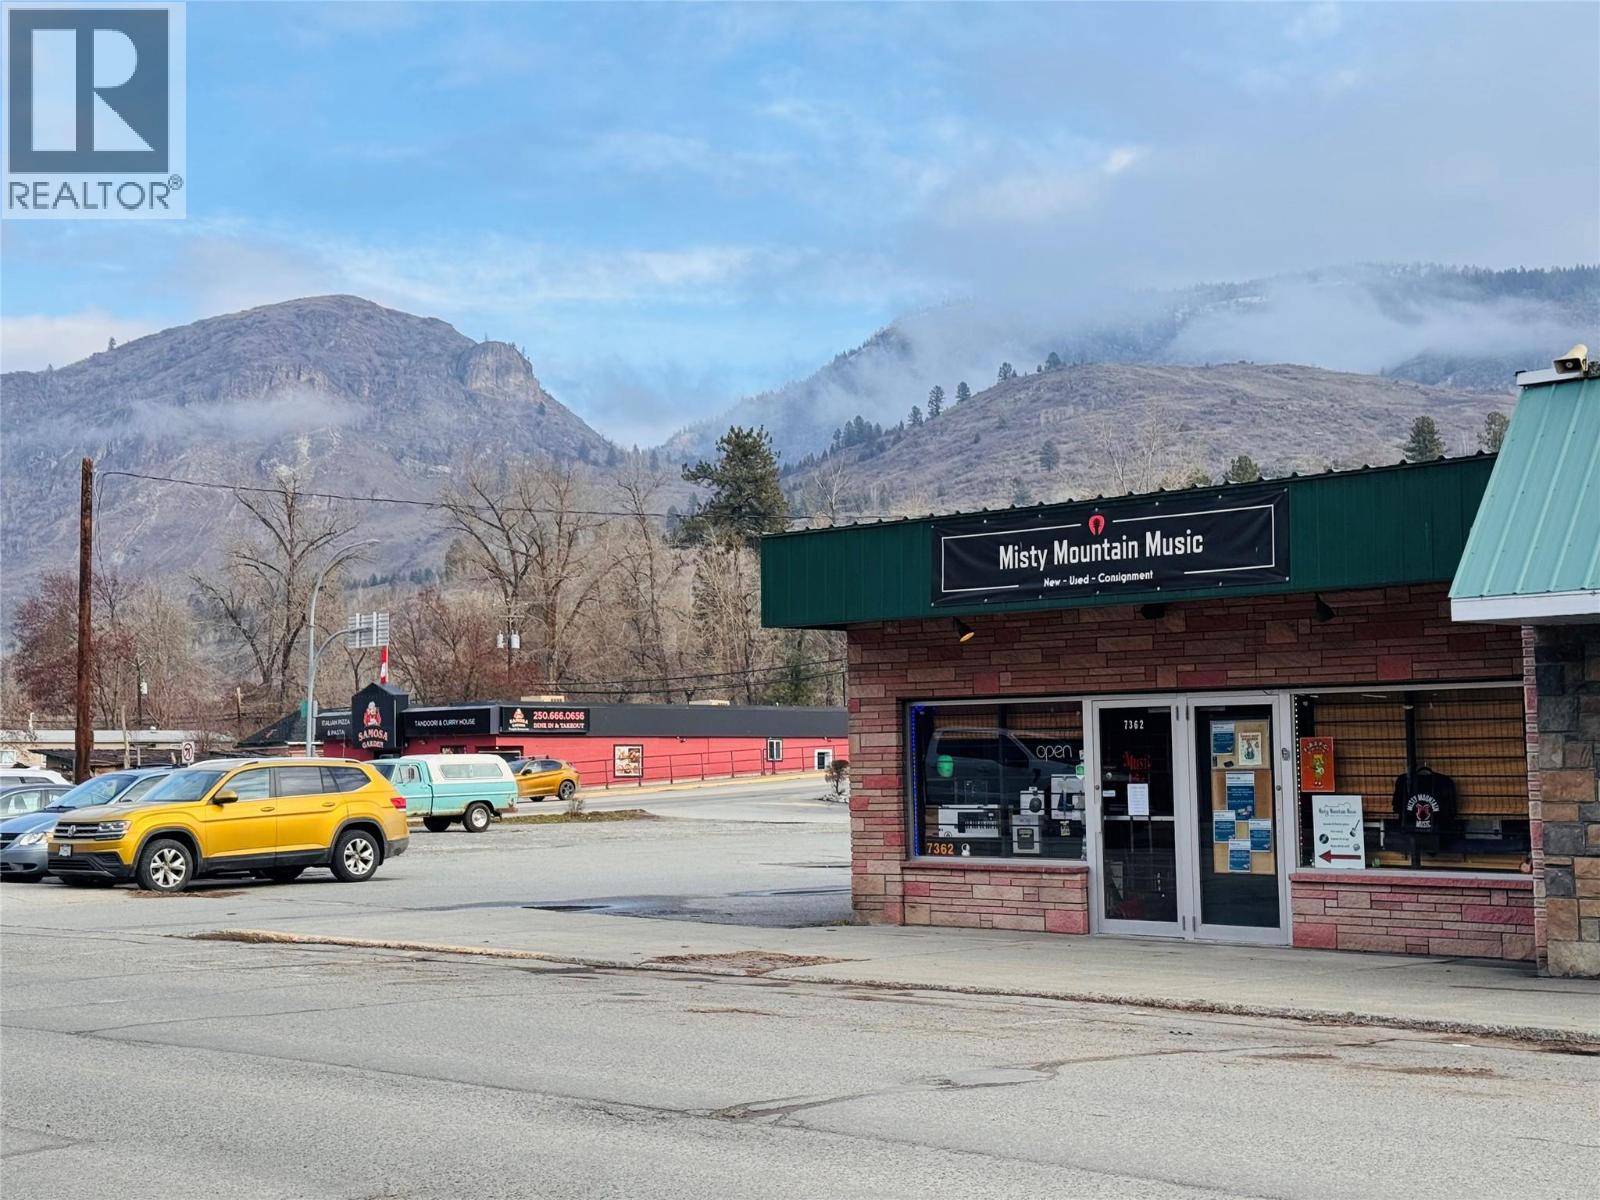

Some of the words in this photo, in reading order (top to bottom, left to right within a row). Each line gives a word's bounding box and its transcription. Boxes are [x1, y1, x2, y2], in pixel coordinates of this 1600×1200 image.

[1000, 545, 1048, 571] Misty
[1053, 535, 1139, 565] Mountain
[1145, 529, 1203, 557] Music
[1043, 577, 1061, 587] New
[1069, 574, 1090, 585] Used
[1098, 569, 1153, 584] Consignment
[533, 711, 585, 720] 250.666.0656
[1124, 720, 1144, 730] 7362
[358, 729, 388, 742] SAMOSA
[1036, 745, 1073, 763] open
[927, 842, 954, 855] 7362
